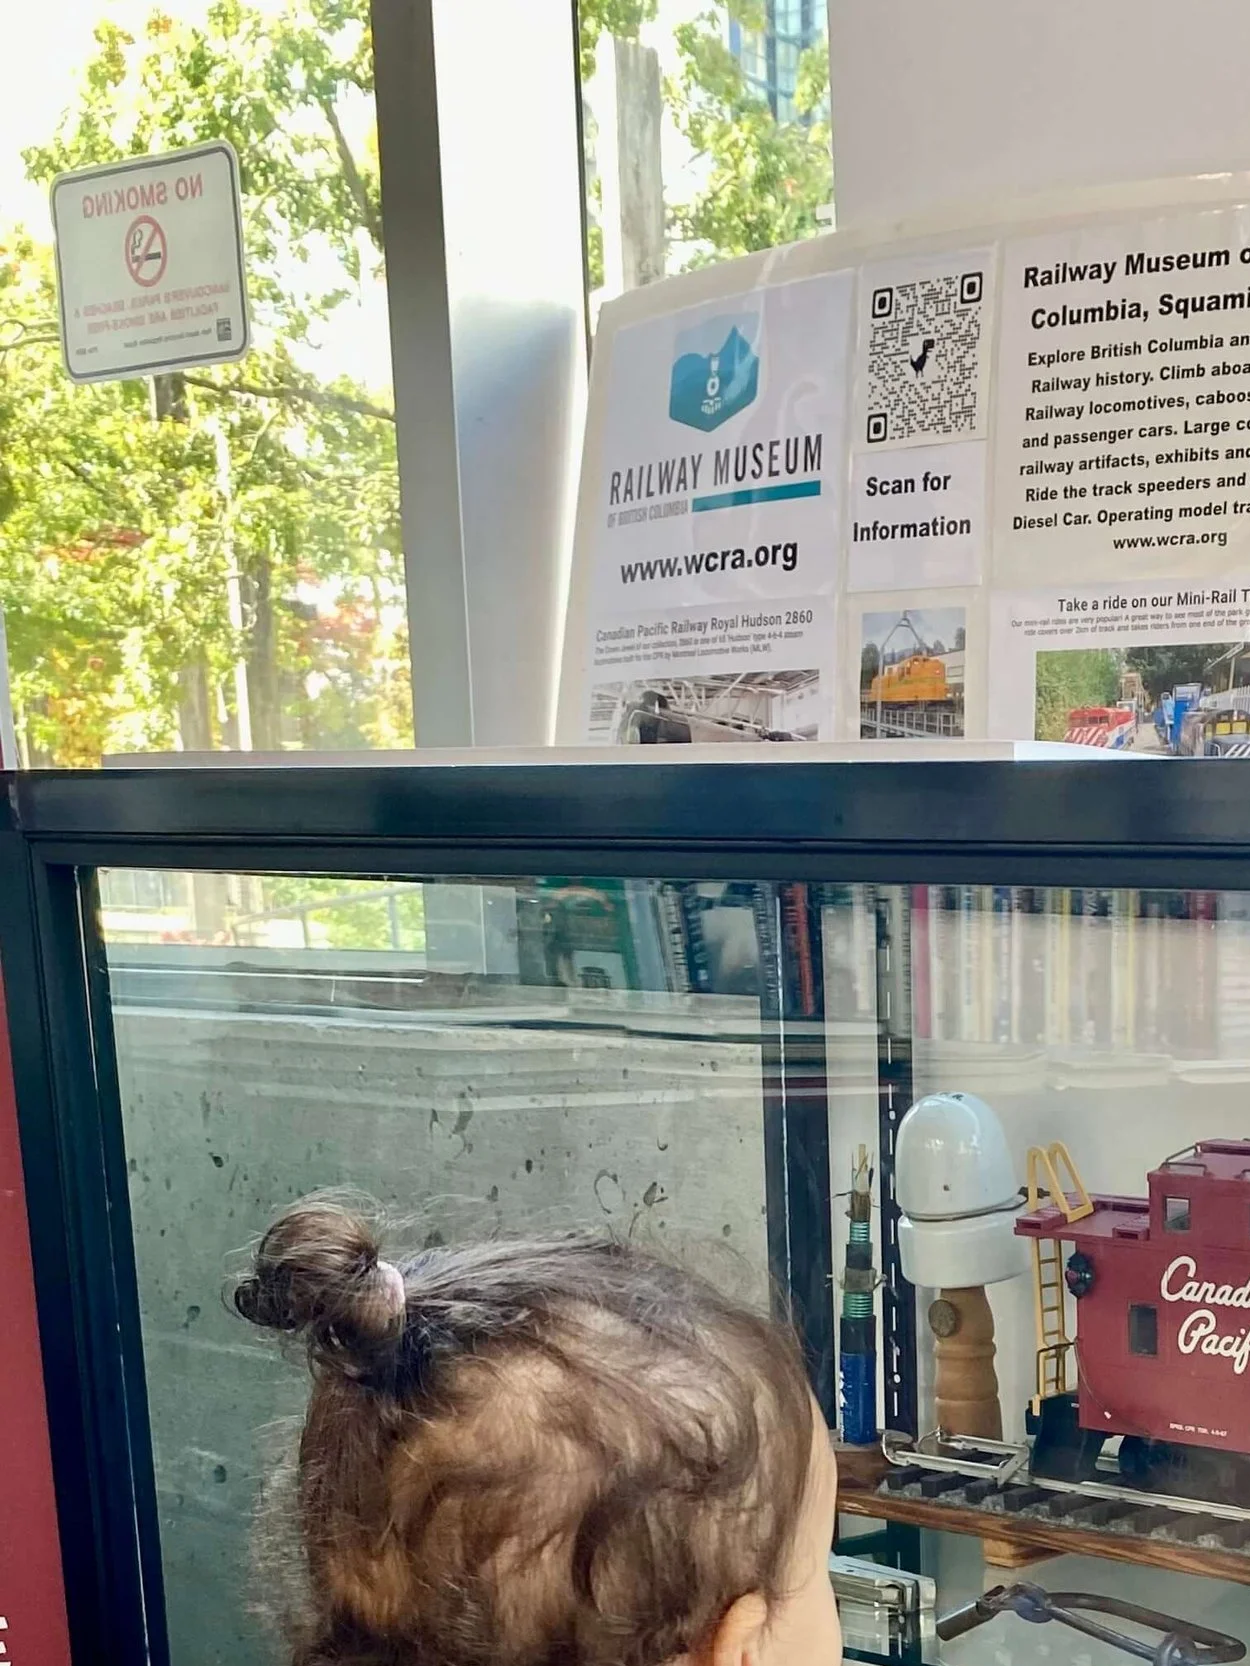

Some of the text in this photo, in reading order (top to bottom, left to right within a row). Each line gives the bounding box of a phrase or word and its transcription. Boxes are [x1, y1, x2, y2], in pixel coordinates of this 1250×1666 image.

[1023, 261, 1117, 288] Railway
[1124, 249, 1229, 275] Museum
[1031, 298, 1148, 329] Columbia,
[1027, 349, 1085, 368] Explore
[1090, 341, 1141, 359] British
[1147, 334, 1223, 353] Columbia
[1025, 405, 1084, 421] Railway
[1089, 395, 1189, 414] locomotives,
[609, 433, 822, 505] RAILWAY MUSEUM
[1019, 460, 1073, 475] railway
[1078, 453, 1149, 470] artifacts,
[1155, 447, 1219, 464] exhibits
[866, 471, 951, 496] Scan for
[853, 515, 970, 542] Information
[1113, 532, 1227, 549] www.wcra.org
[620, 542, 797, 583] www.wcra.org
[1057, 597, 1088, 612] Take
[1091, 600, 1098, 610] a
[1103, 594, 1127, 609] ride
[1131, 597, 1146, 608] on
[1151, 596, 1173, 607] our
[1176, 588, 1236, 605] Mini-Rail
[595, 609, 812, 642] Canadian Pacific Railway Royal Hudson 2860
